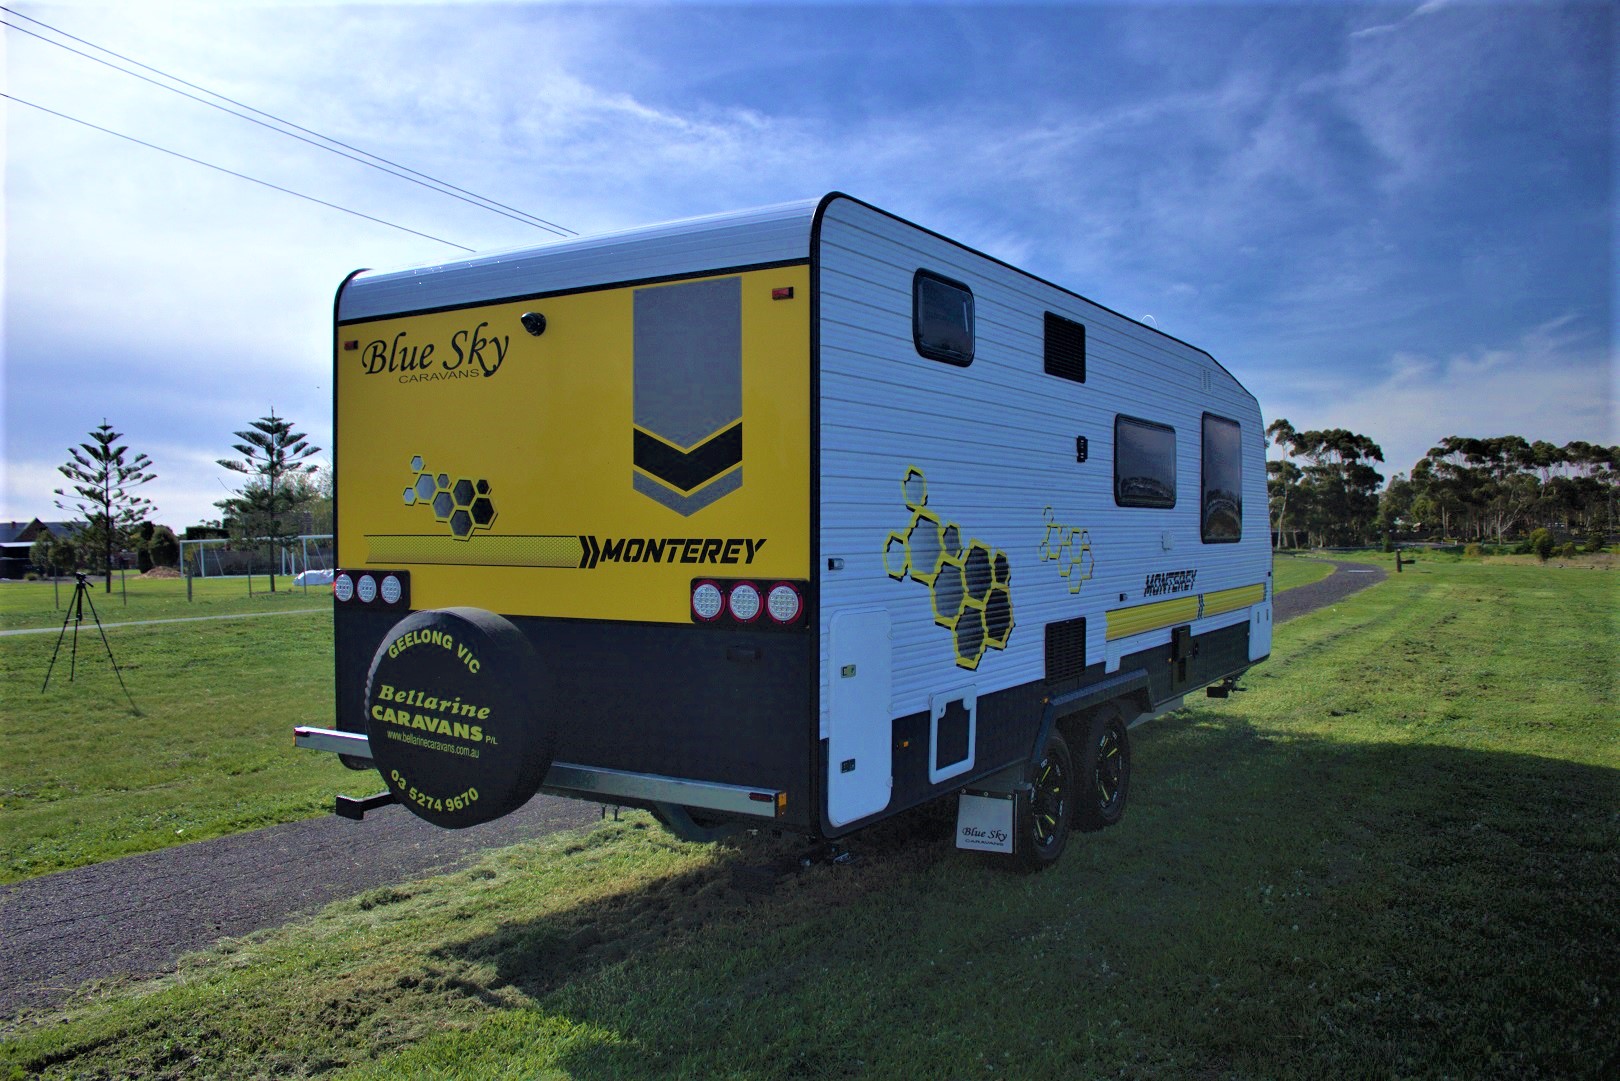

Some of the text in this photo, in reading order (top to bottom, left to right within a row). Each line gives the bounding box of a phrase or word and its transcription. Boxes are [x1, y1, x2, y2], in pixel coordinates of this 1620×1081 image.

[362, 322, 509, 378] Blue Sky
[398, 368, 480, 384] CARAVANS
[600, 538, 767, 565] MONTEREY
[388, 629, 481, 674] GEELONG VIC
[378, 684, 491, 720] Bellarine
[372, 705, 484, 742] CARAVANS
[387, 729, 480, 759] www.bellarinecaravans.com.au
[391, 769, 479, 812] 03 5274 9670
[962, 827, 1008, 842] Blue Sky
